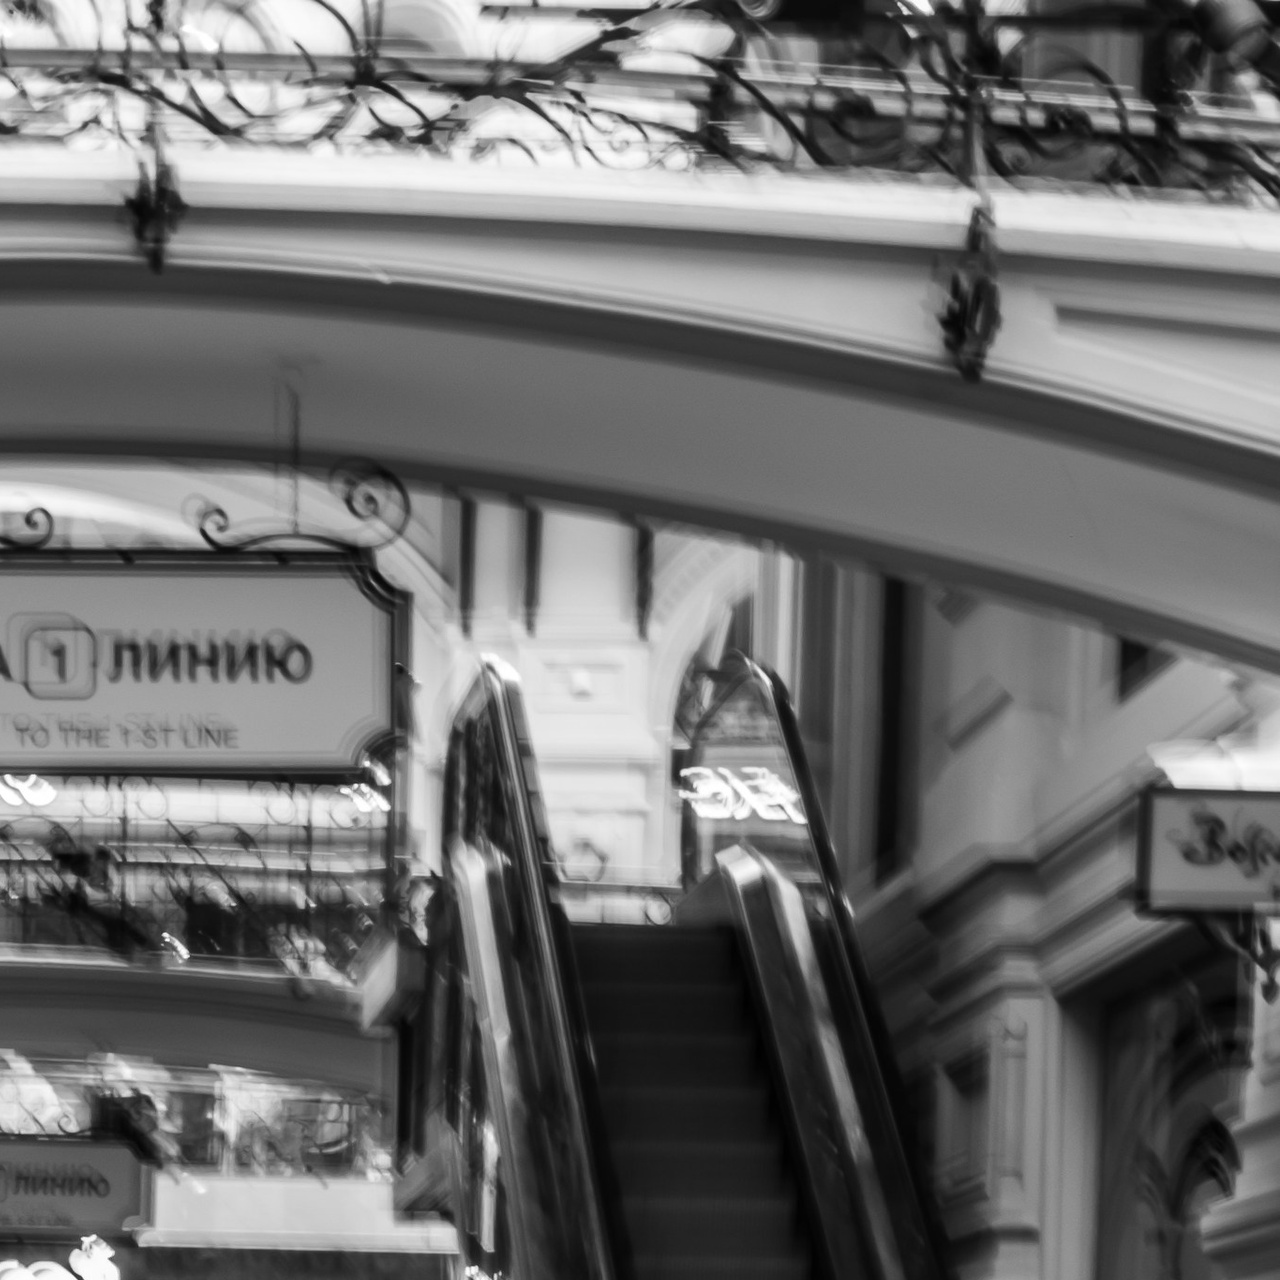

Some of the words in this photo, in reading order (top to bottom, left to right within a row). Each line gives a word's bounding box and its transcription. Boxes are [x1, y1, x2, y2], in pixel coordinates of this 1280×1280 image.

[108, 639, 314, 685] ЛИНИЮ
[14, 727, 50, 749] TO
[59, 727, 110, 749] THE
[183, 727, 240, 749] LINE
[11, 1171, 111, 1198] ЛИНИЮ
